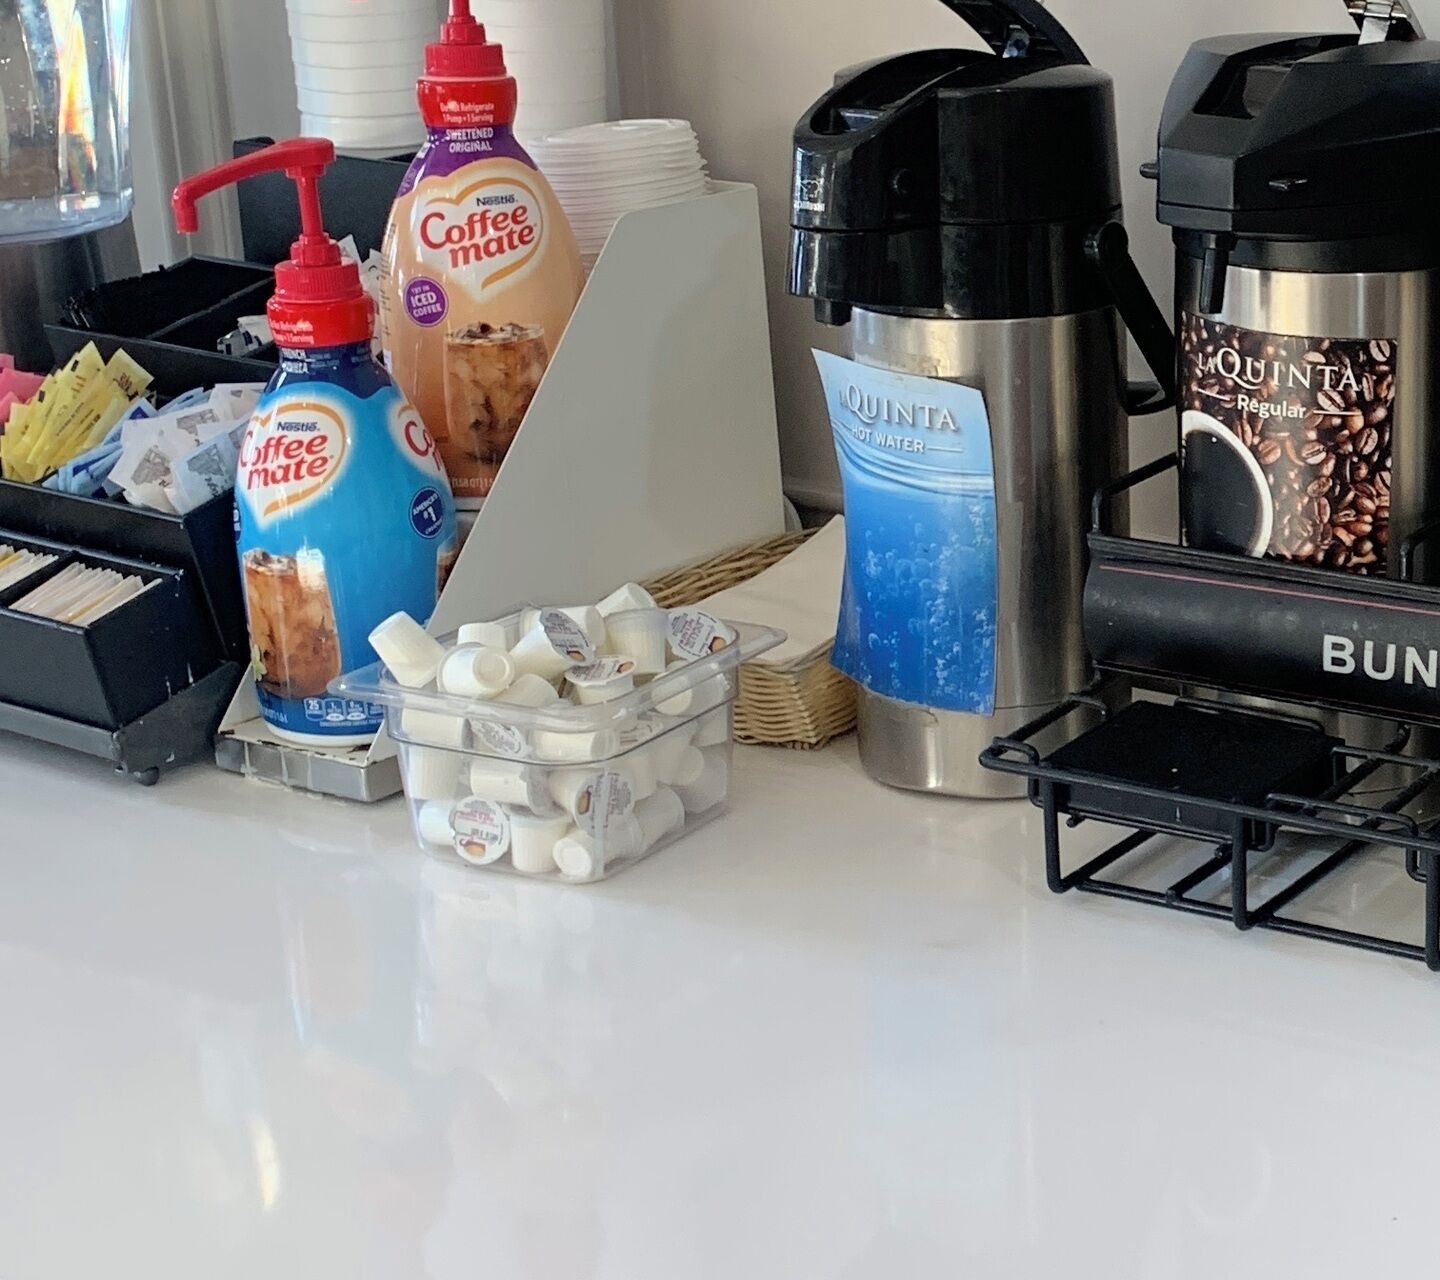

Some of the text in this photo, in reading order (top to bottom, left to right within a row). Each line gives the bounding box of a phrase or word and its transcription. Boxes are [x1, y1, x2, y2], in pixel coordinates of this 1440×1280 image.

[460, 102, 495, 113] Refrigerate
[471, 113, 494, 123] Serving
[446, 127, 494, 141] SWEETENED
[449, 140, 493, 153] ORIGINAL
[420, 204, 529, 250] Coffee
[448, 224, 536, 269] mate
[411, 291, 437, 308] ICED
[413, 303, 443, 318] COFFEE
[1198, 347, 1361, 392] LA QUINTA
[846, 383, 960, 433] QUINTA
[1237, 393, 1306, 419] Regular
[851, 424, 926, 454] HOT WATER
[247, 455, 329, 490] mate
